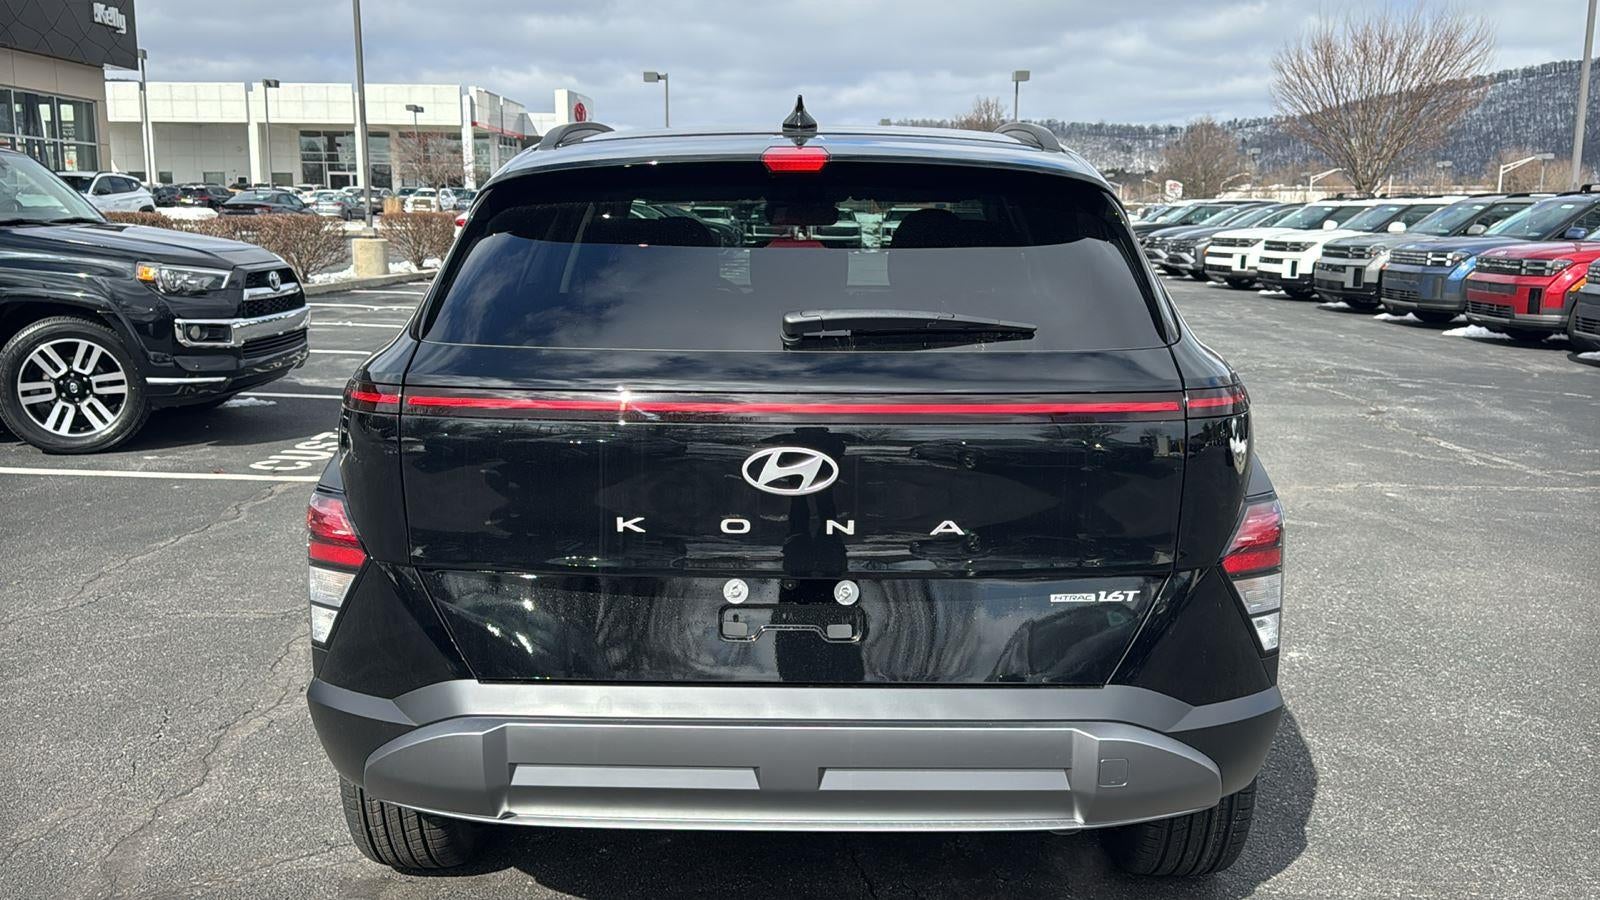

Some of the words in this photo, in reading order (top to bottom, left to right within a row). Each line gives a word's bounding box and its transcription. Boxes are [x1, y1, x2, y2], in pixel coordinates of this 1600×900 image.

[93, 2, 127, 34] Kelly
[249, 427, 339, 471] CUST
[616, 516, 966, 536] KONA
